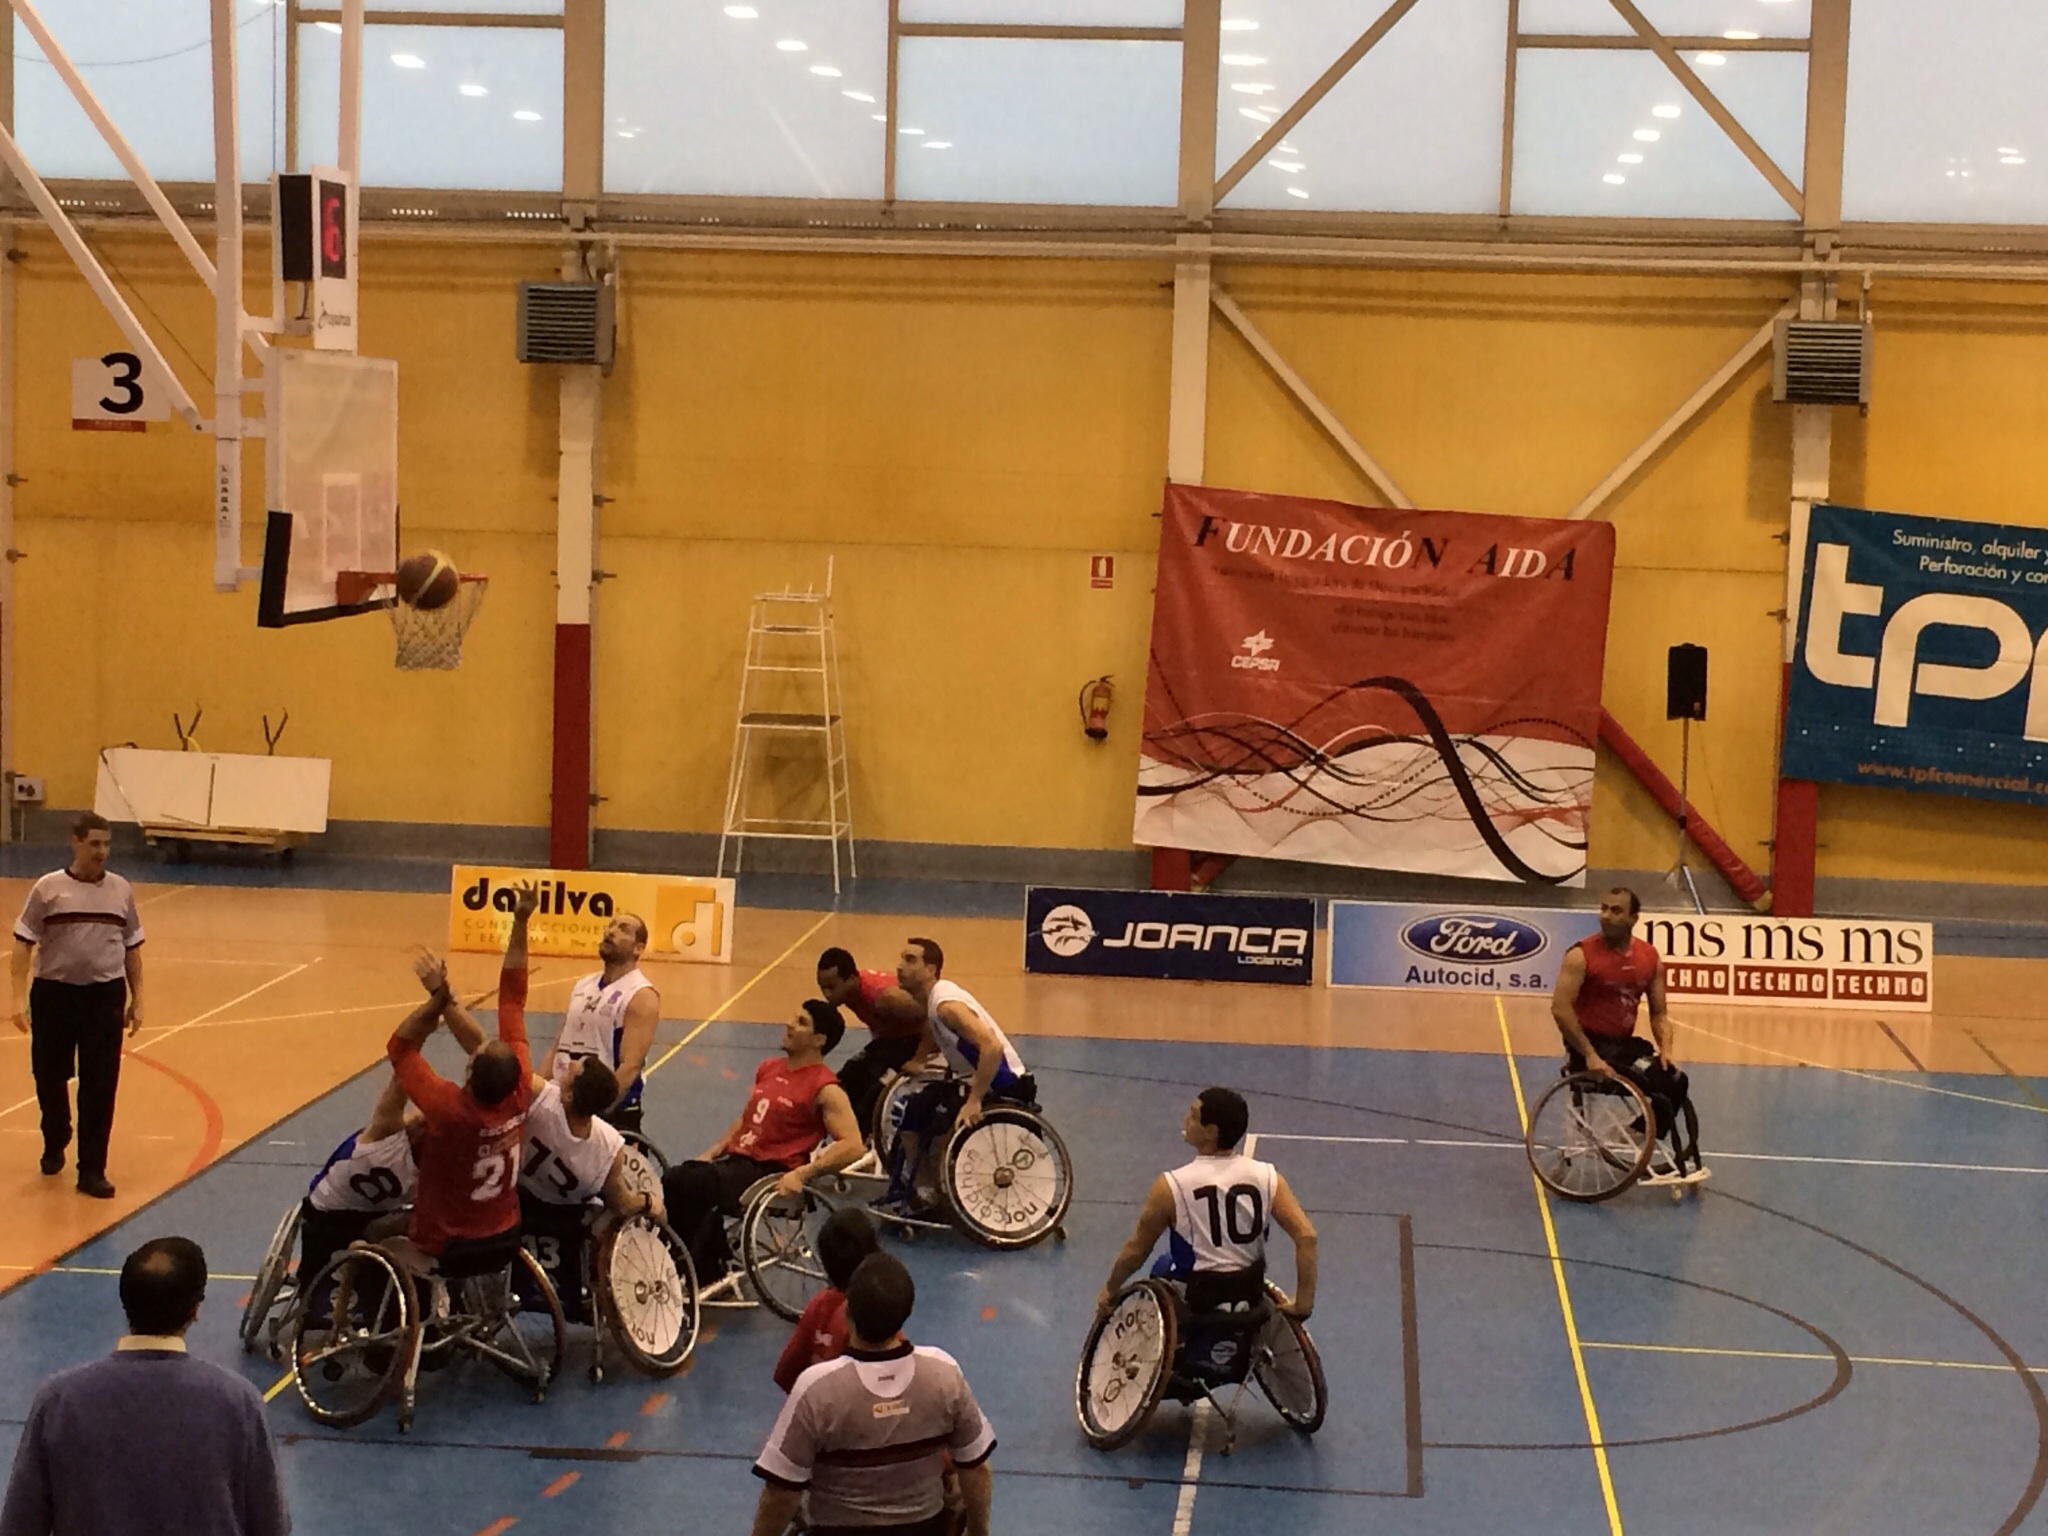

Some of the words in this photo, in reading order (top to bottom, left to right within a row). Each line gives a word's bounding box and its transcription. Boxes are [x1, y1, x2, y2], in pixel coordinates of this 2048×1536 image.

[99, 352, 144, 414] 3
[1193, 515, 1449, 569] FUNDACIÓN
[1467, 542, 1576, 581] AIDA
[1893, 528, 1976, 556] Suministro,
[2010, 569, 2022, 585] y
[1231, 655, 1280, 671] CEPSA
[463, 878, 614, 917] dailva
[1102, 921, 1308, 955] JOANCA
[1430, 918, 1518, 956] Ford
[1644, 919, 1726, 959] ms
[1741, 923, 1825, 961] ms
[1840, 927, 1923, 965] ms
[1405, 965, 1501, 990] Autocid,
[1508, 973, 1548, 988] s.a.
[1737, 970, 1825, 993] TECHNO
[1836, 974, 1925, 997] TECHNO
[752, 1098, 769, 1124] 9
[350, 1166, 402, 1205] 8
[471, 1142, 521, 1200] 21
[1193, 1183, 1263, 1248] 10
